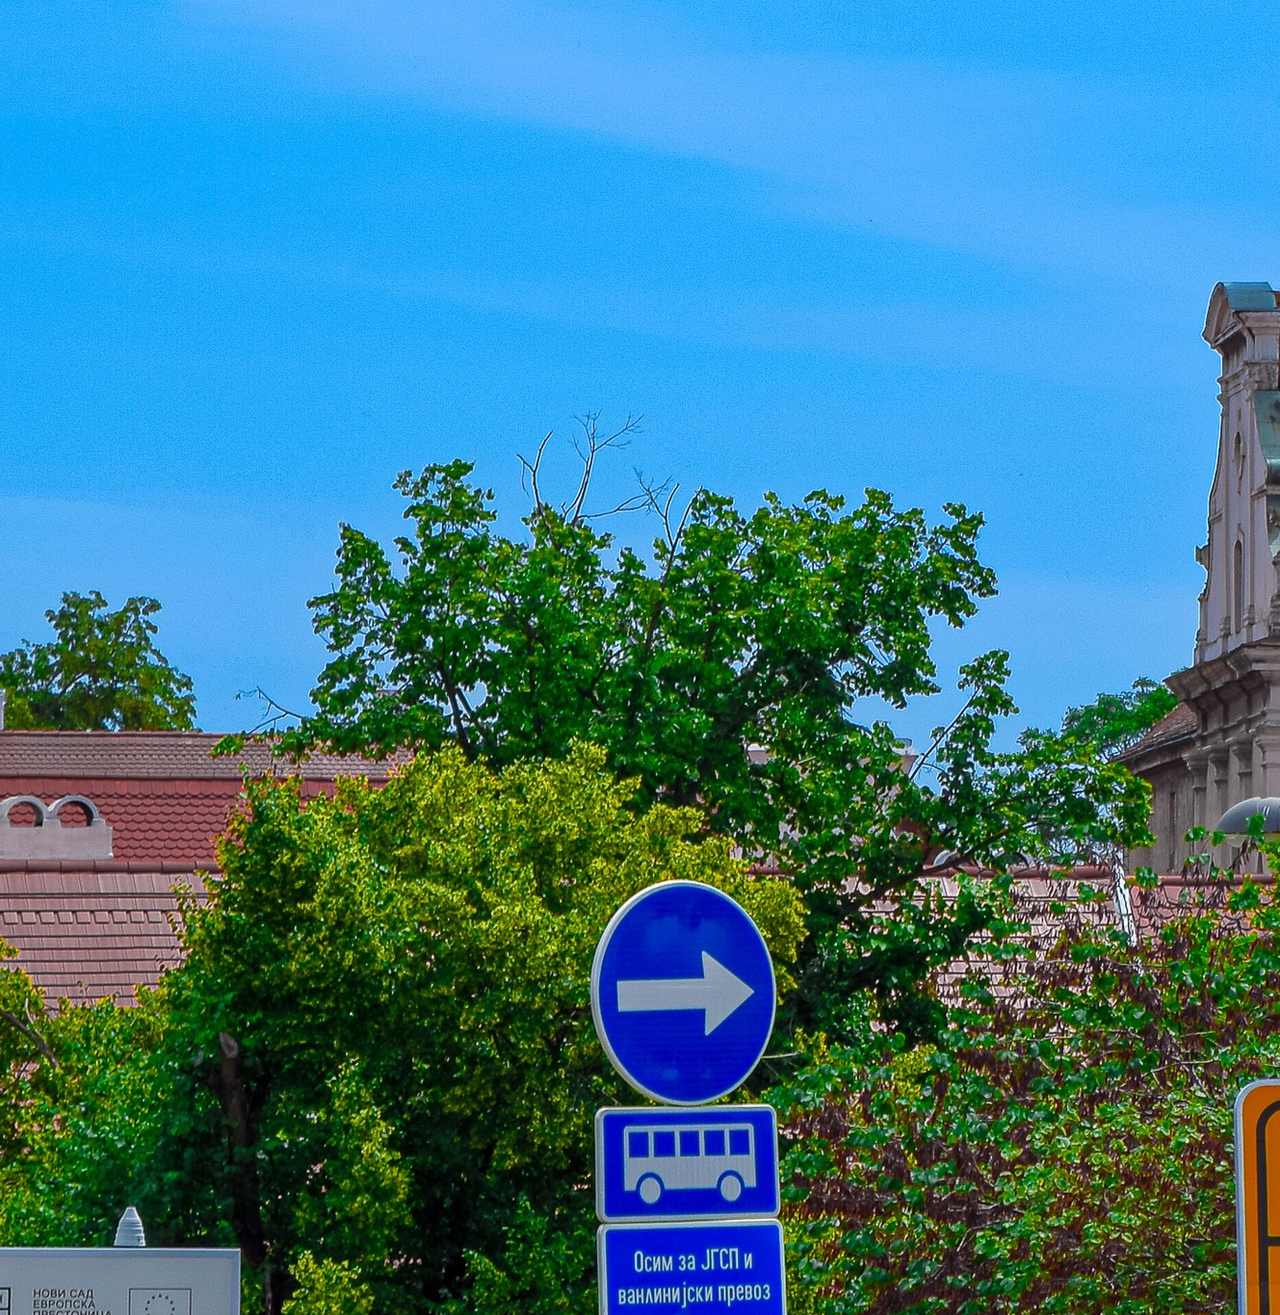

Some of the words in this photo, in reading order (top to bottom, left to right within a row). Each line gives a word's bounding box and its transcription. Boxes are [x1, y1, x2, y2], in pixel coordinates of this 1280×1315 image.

[633, 1250, 673, 1273] Осим
[678, 1254, 696, 1271] за
[701, 1247, 739, 1271] ЈГСП
[744, 1252, 753, 1269] и
[32, 1288, 66, 1299] НОВИ
[69, 1288, 95, 1300] САД
[617, 1282, 713, 1308] ванлинијски
[717, 1283, 771, 1307] превоз
[32, 1299, 96, 1310] ЕВРОПСКА
